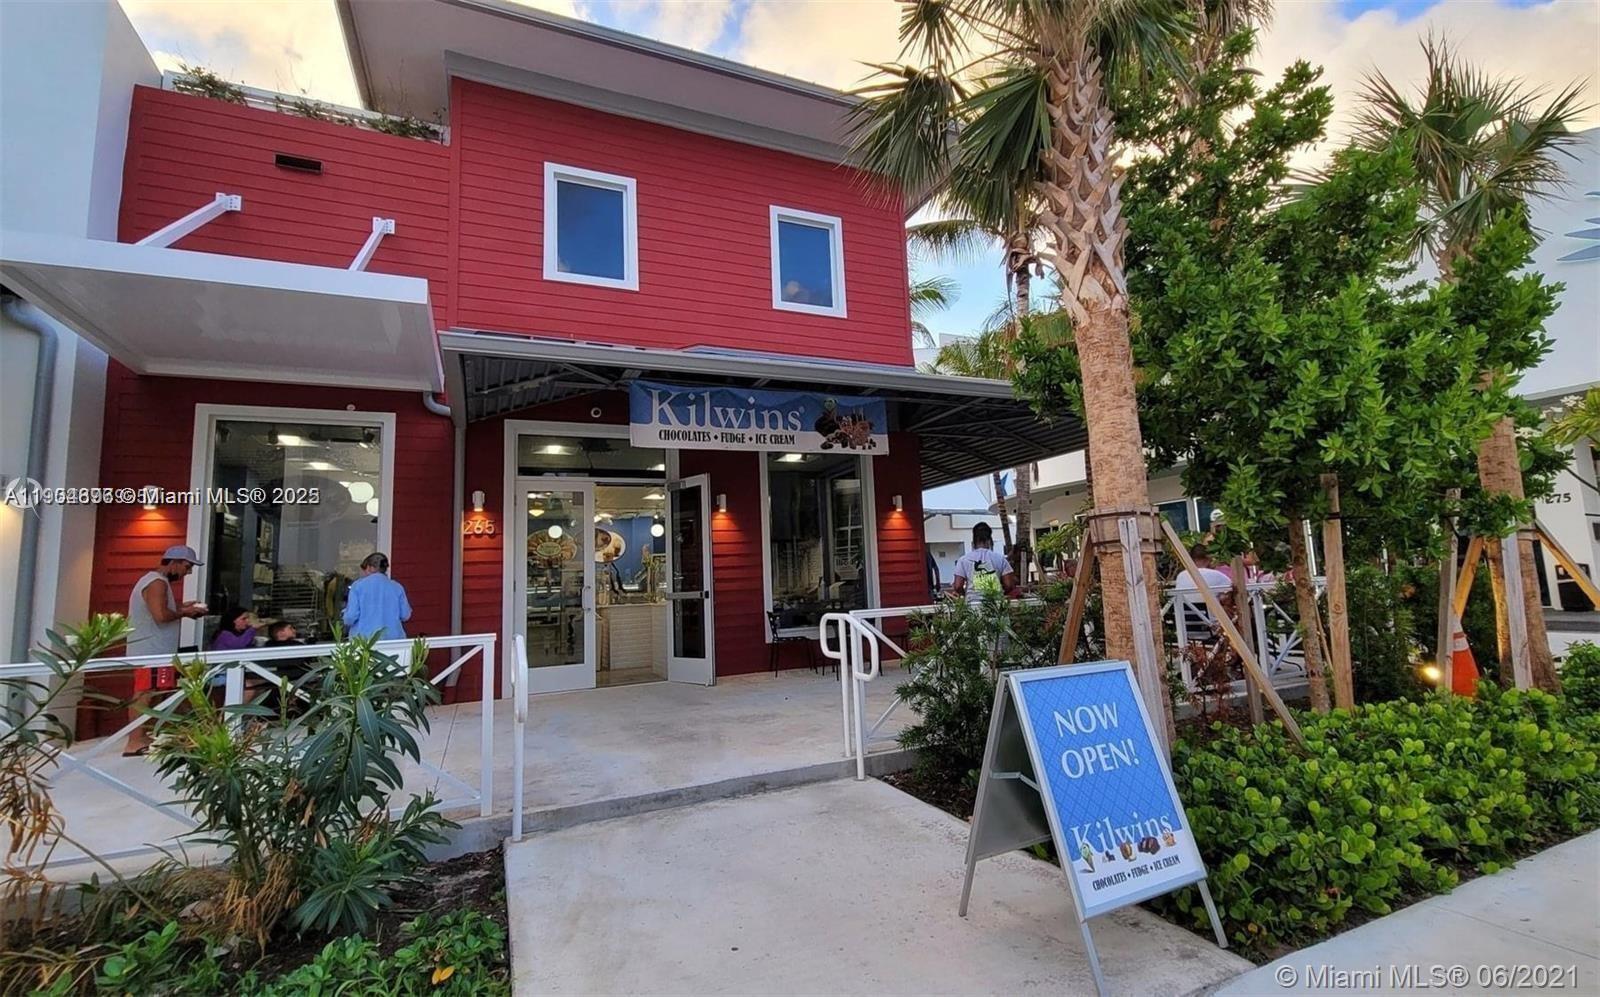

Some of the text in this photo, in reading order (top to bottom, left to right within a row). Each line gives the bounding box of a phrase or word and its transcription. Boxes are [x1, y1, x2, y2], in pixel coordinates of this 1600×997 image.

[648, 388, 802, 432] Kilwins
[658, 429, 795, 445] CHOCOLATES FUDGE ICE CREAM
[464, 519, 496, 534] 265
[1053, 702, 1119, 737] NOW
[1061, 738, 1139, 778] OPEN!
[1071, 811, 1172, 854] Kilwins
[1092, 854, 1181, 891] CHOCOLATES FUDGE ICE CREAM
